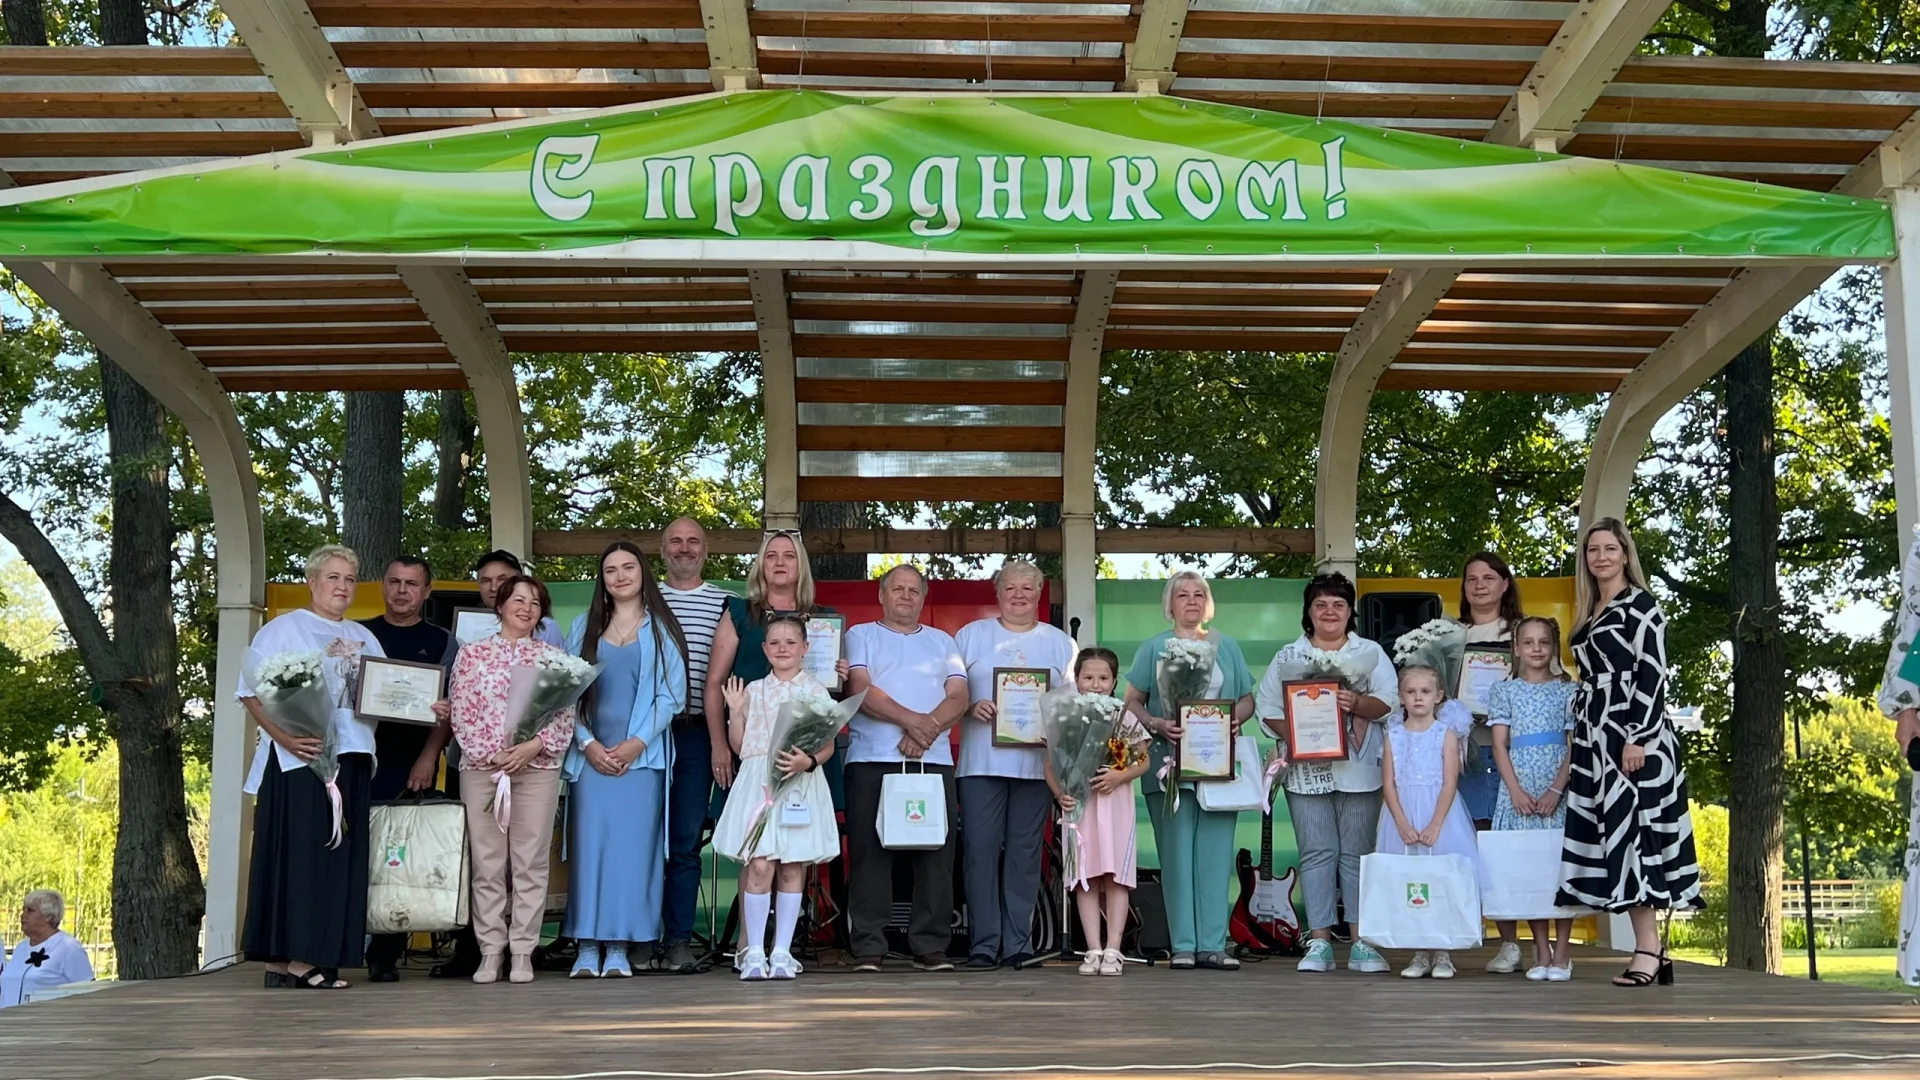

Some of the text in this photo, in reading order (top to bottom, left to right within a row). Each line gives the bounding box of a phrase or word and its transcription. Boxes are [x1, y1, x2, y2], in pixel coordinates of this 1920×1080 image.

[530, 133, 1347, 237] С праздником!
[1312, 772, 1334, 785] TRE
